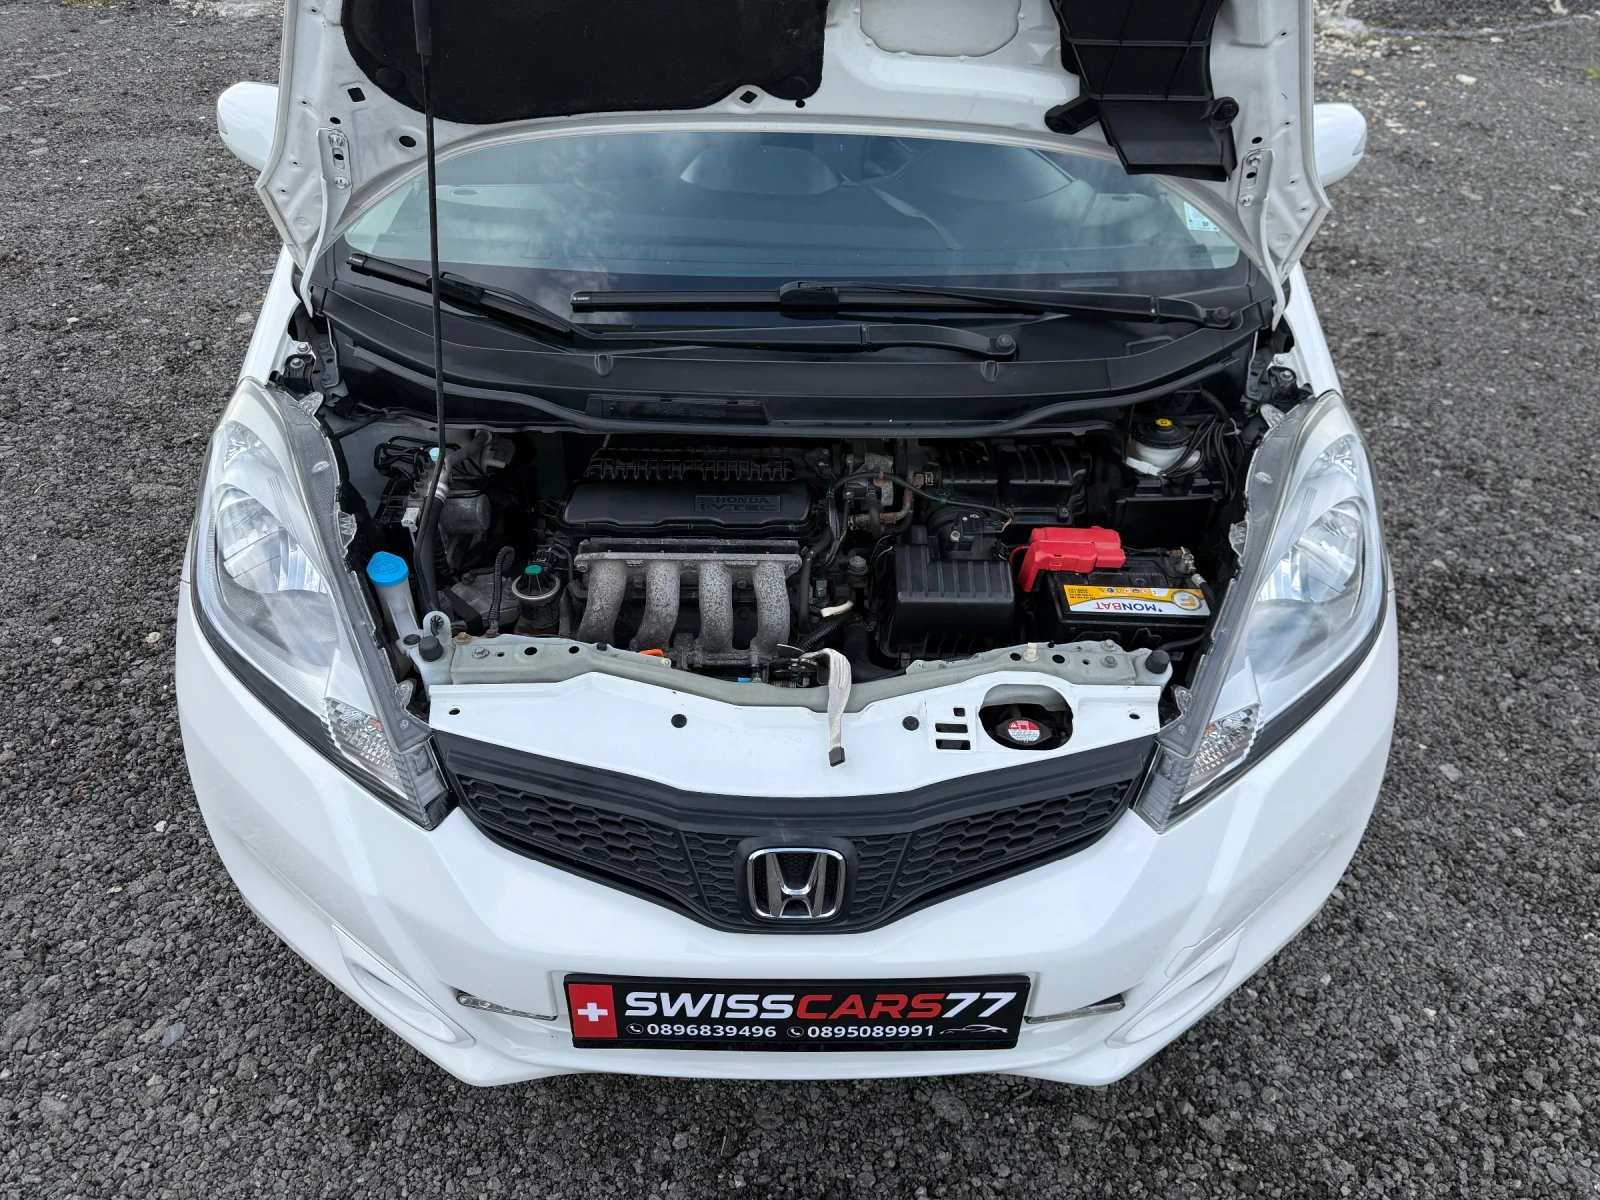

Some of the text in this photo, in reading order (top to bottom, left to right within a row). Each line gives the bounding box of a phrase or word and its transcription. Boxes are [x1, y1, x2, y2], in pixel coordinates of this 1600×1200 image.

[715, 496, 770, 504] HONDA
[1095, 601, 1157, 613] MONBAT
[625, 991, 1017, 1019] SWISSCARS77
[647, 1023, 934, 1038] 0896839496 0895089991
